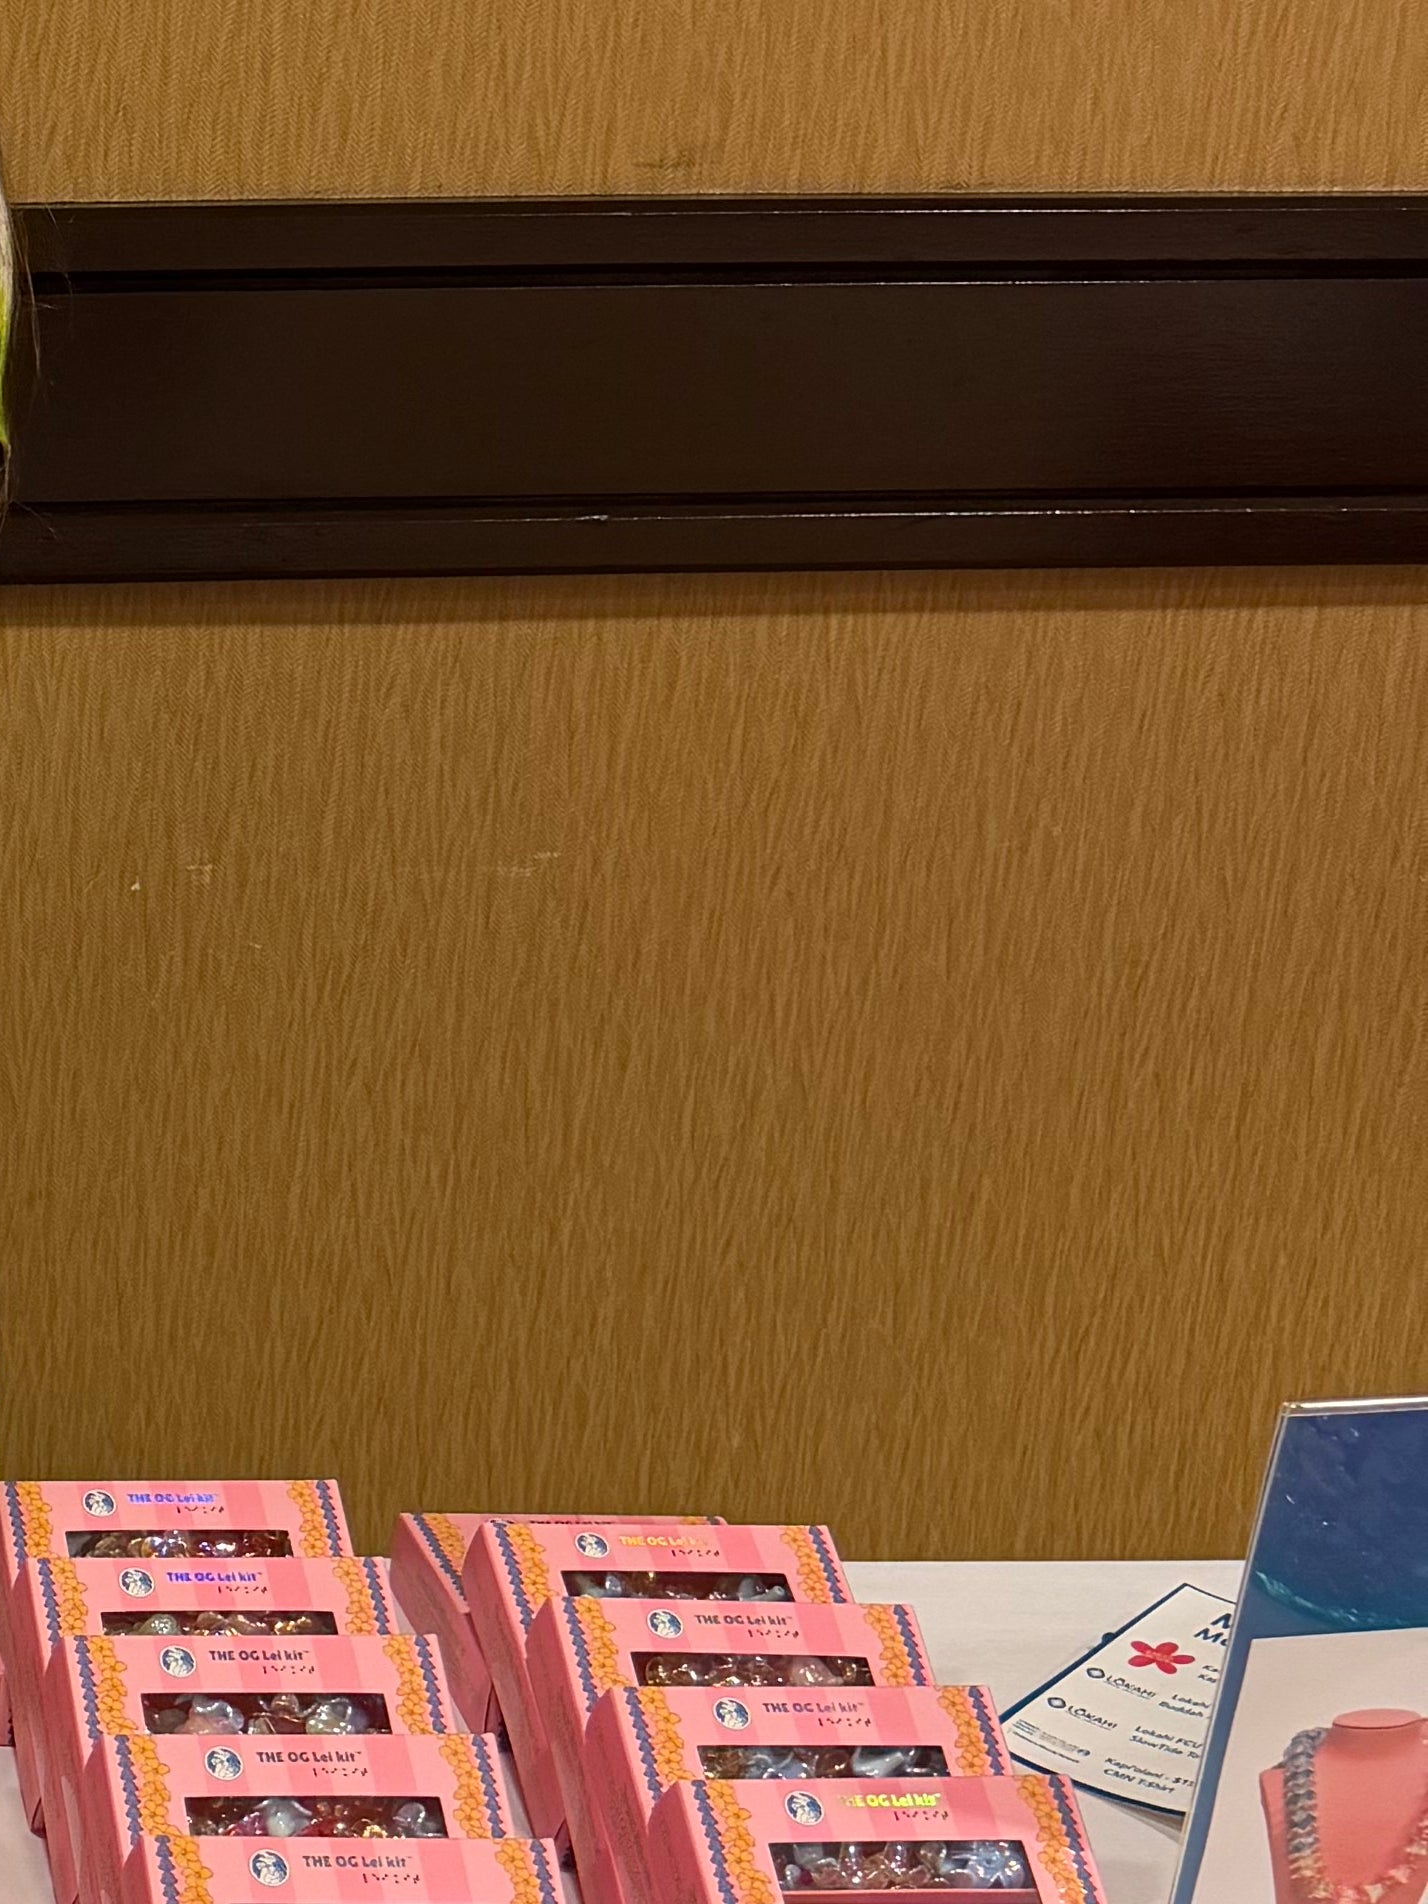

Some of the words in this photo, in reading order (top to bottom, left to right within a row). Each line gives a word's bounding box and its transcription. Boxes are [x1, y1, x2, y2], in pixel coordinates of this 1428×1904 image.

[694, 1615, 720, 1625] THE
[724, 1615, 744, 1625] OG
[747, 1615, 766, 1625] Lei
[209, 1650, 236, 1661] THE
[239, 1650, 259, 1661] OG
[262, 1650, 282, 1661] Lei
[762, 1702, 790, 1713] THE
[793, 1702, 814, 1713] OG
[816, 1703, 836, 1712] Lei
[256, 1751, 285, 1763] THE
[288, 1752, 310, 1762] OG
[313, 1751, 333, 1762] Lei
